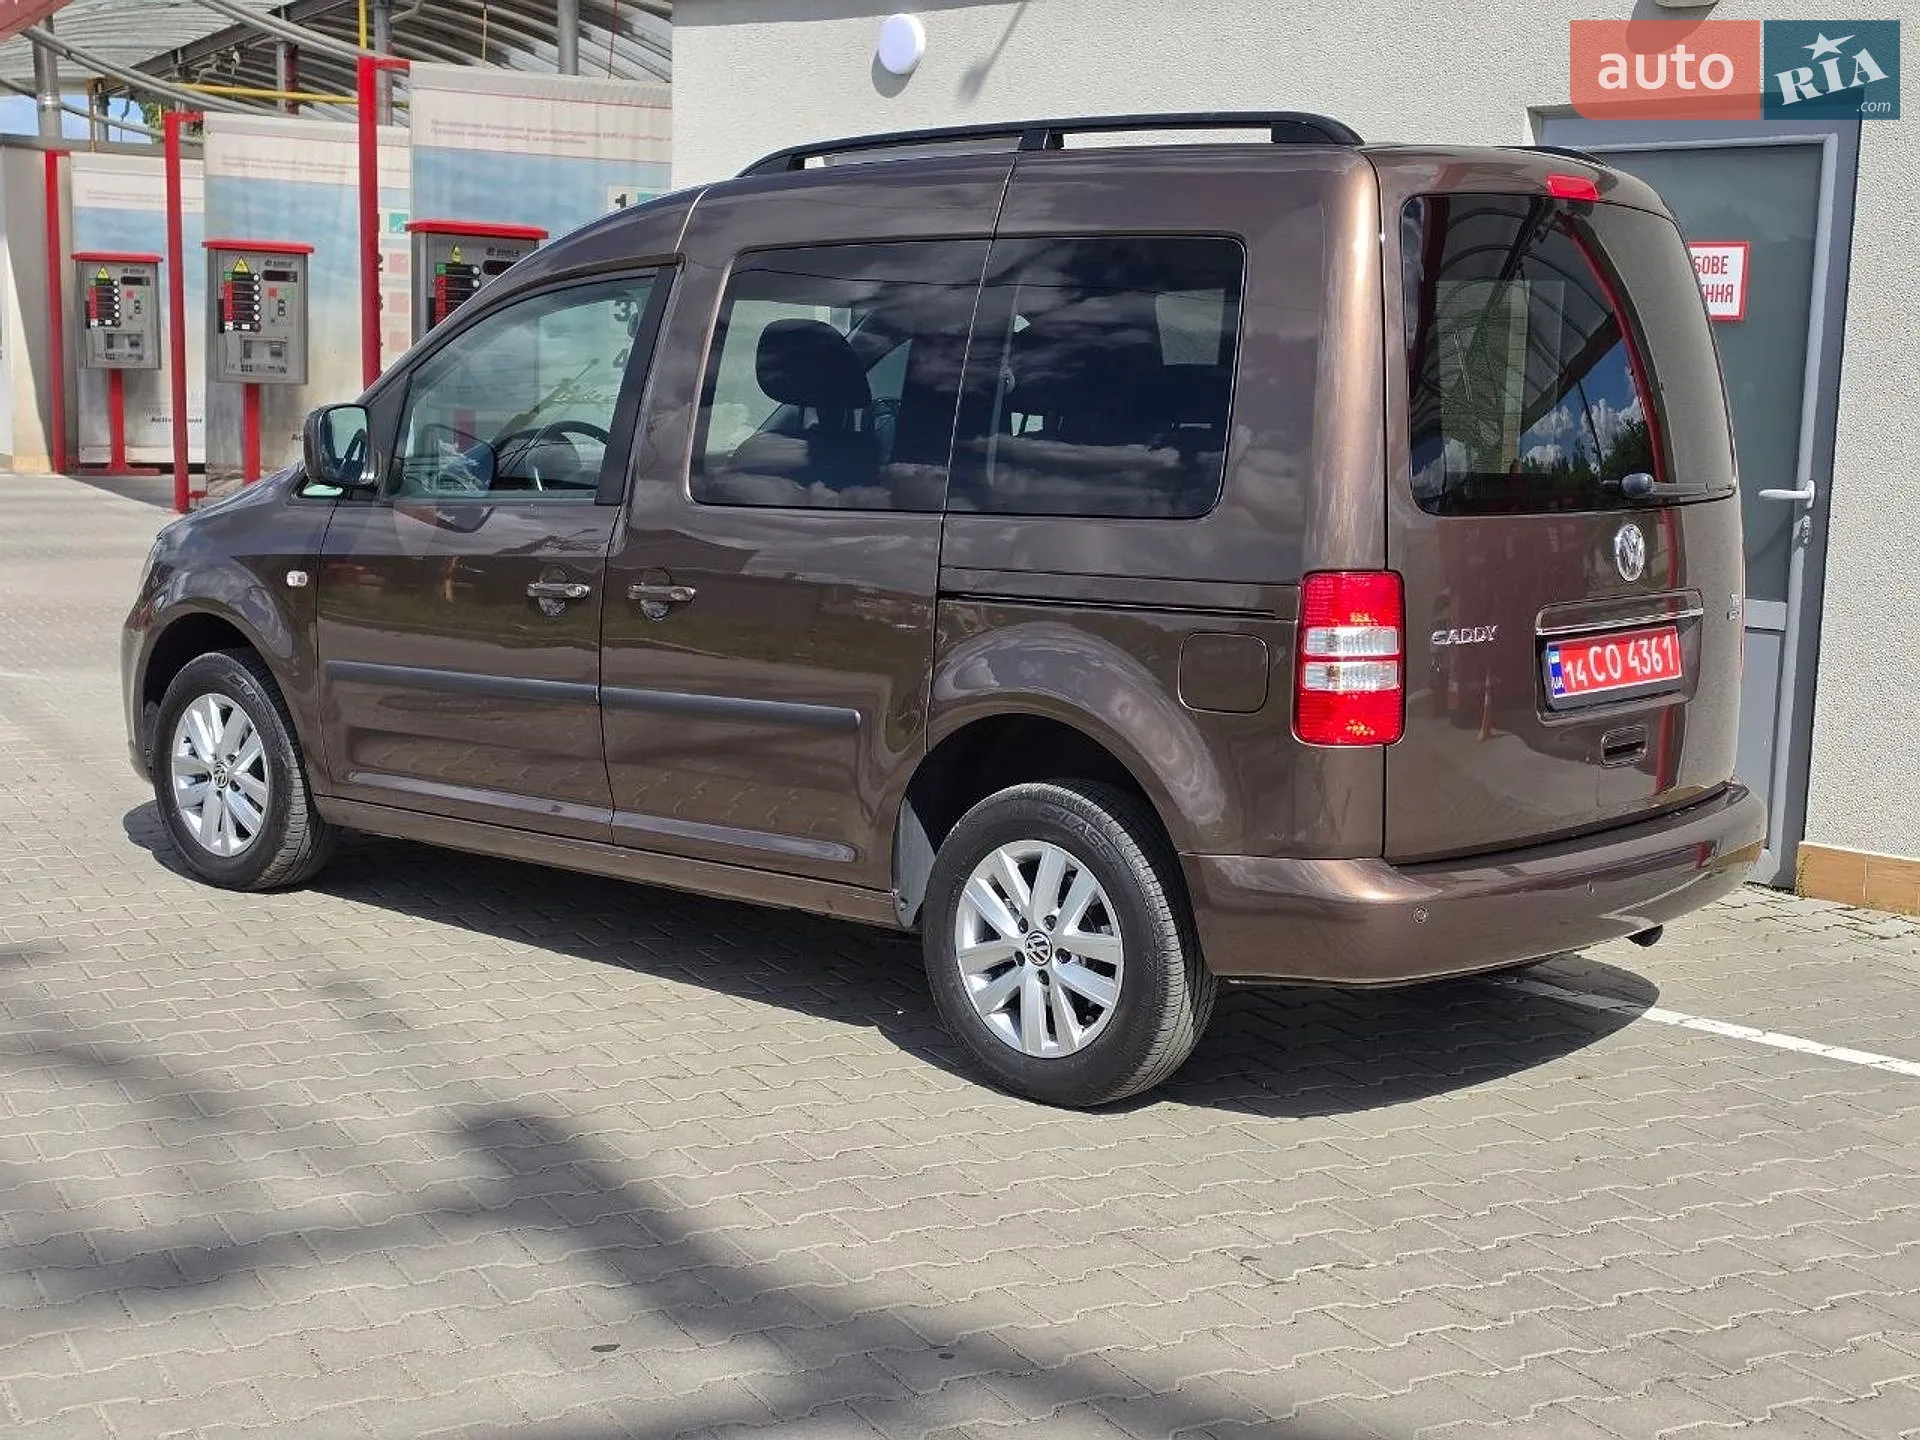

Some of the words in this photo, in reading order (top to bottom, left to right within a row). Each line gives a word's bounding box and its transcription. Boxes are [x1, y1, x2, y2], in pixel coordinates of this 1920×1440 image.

[1693, 255, 1729, 274] БОВЕ
[1702, 283, 1734, 303] ННЯ
[1431, 625, 1498, 645] CADDY
[1628, 634, 1674, 677] 4361
